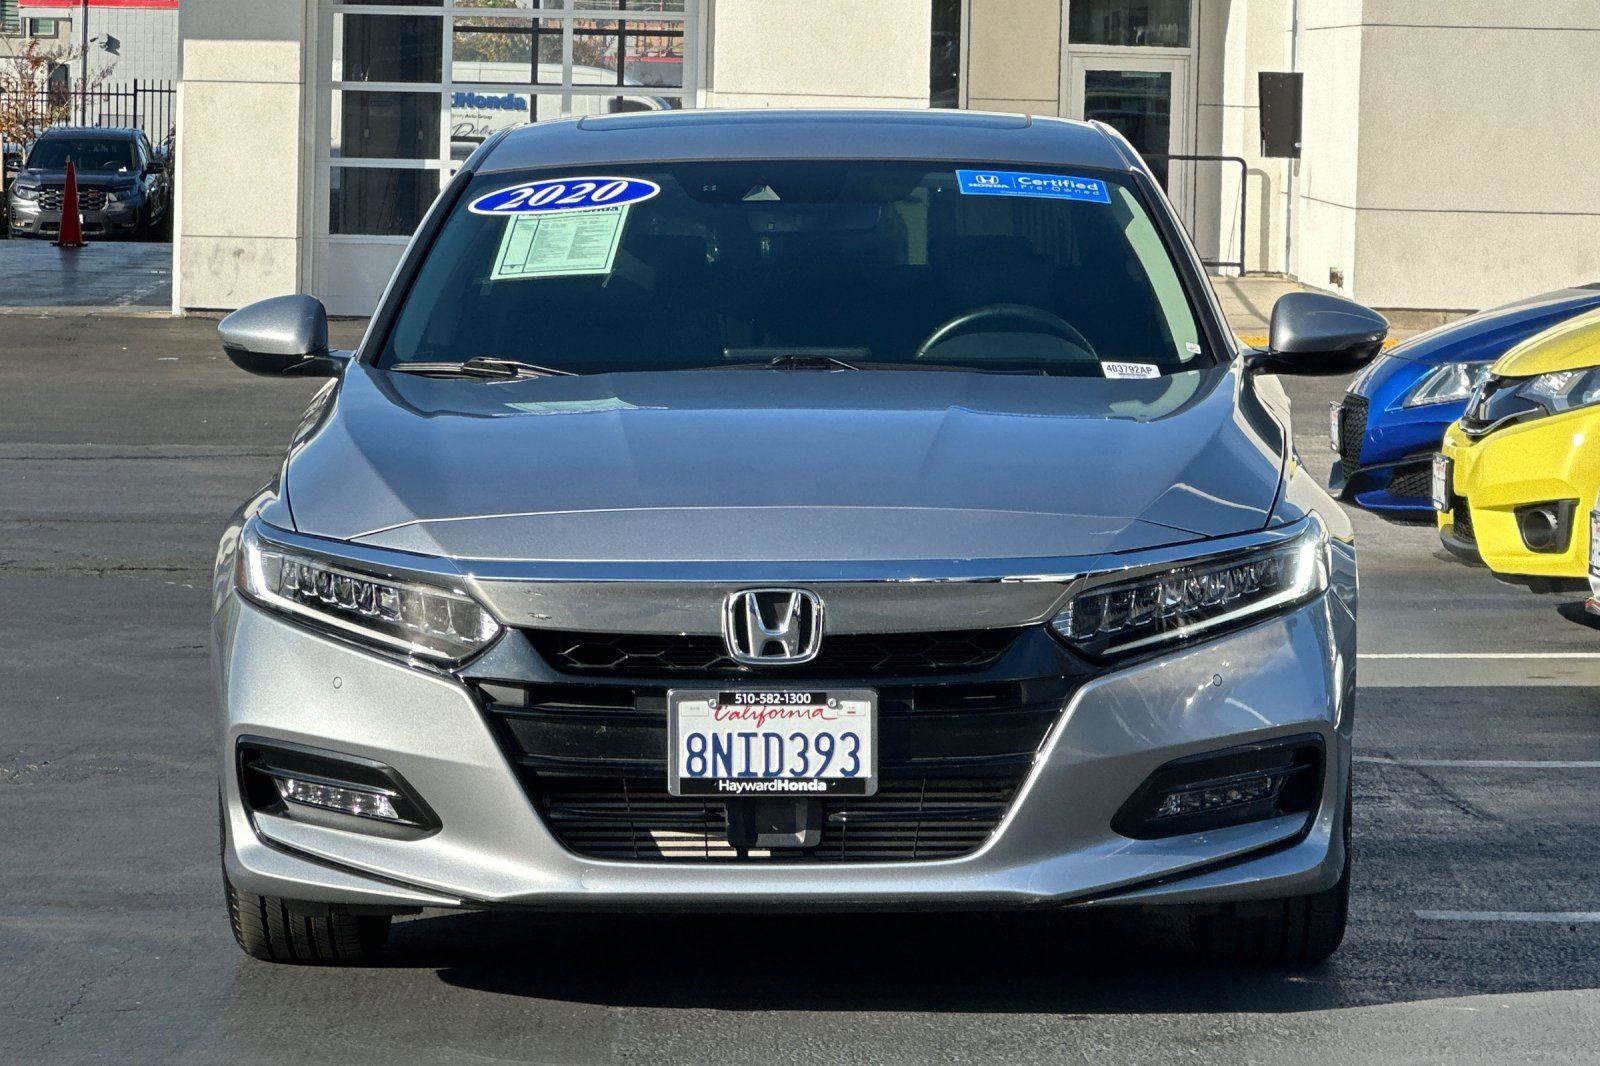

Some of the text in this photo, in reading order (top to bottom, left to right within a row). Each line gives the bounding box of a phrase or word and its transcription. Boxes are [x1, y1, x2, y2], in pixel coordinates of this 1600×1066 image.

[1017, 176, 1099, 191] Certified
[1020, 185, 1101, 196] Pre-Owned
[493, 180, 630, 211] 2020
[734, 693, 812, 704] 510-582-1300
[714, 704, 838, 728] California
[686, 732, 860, 777] 8NID393
